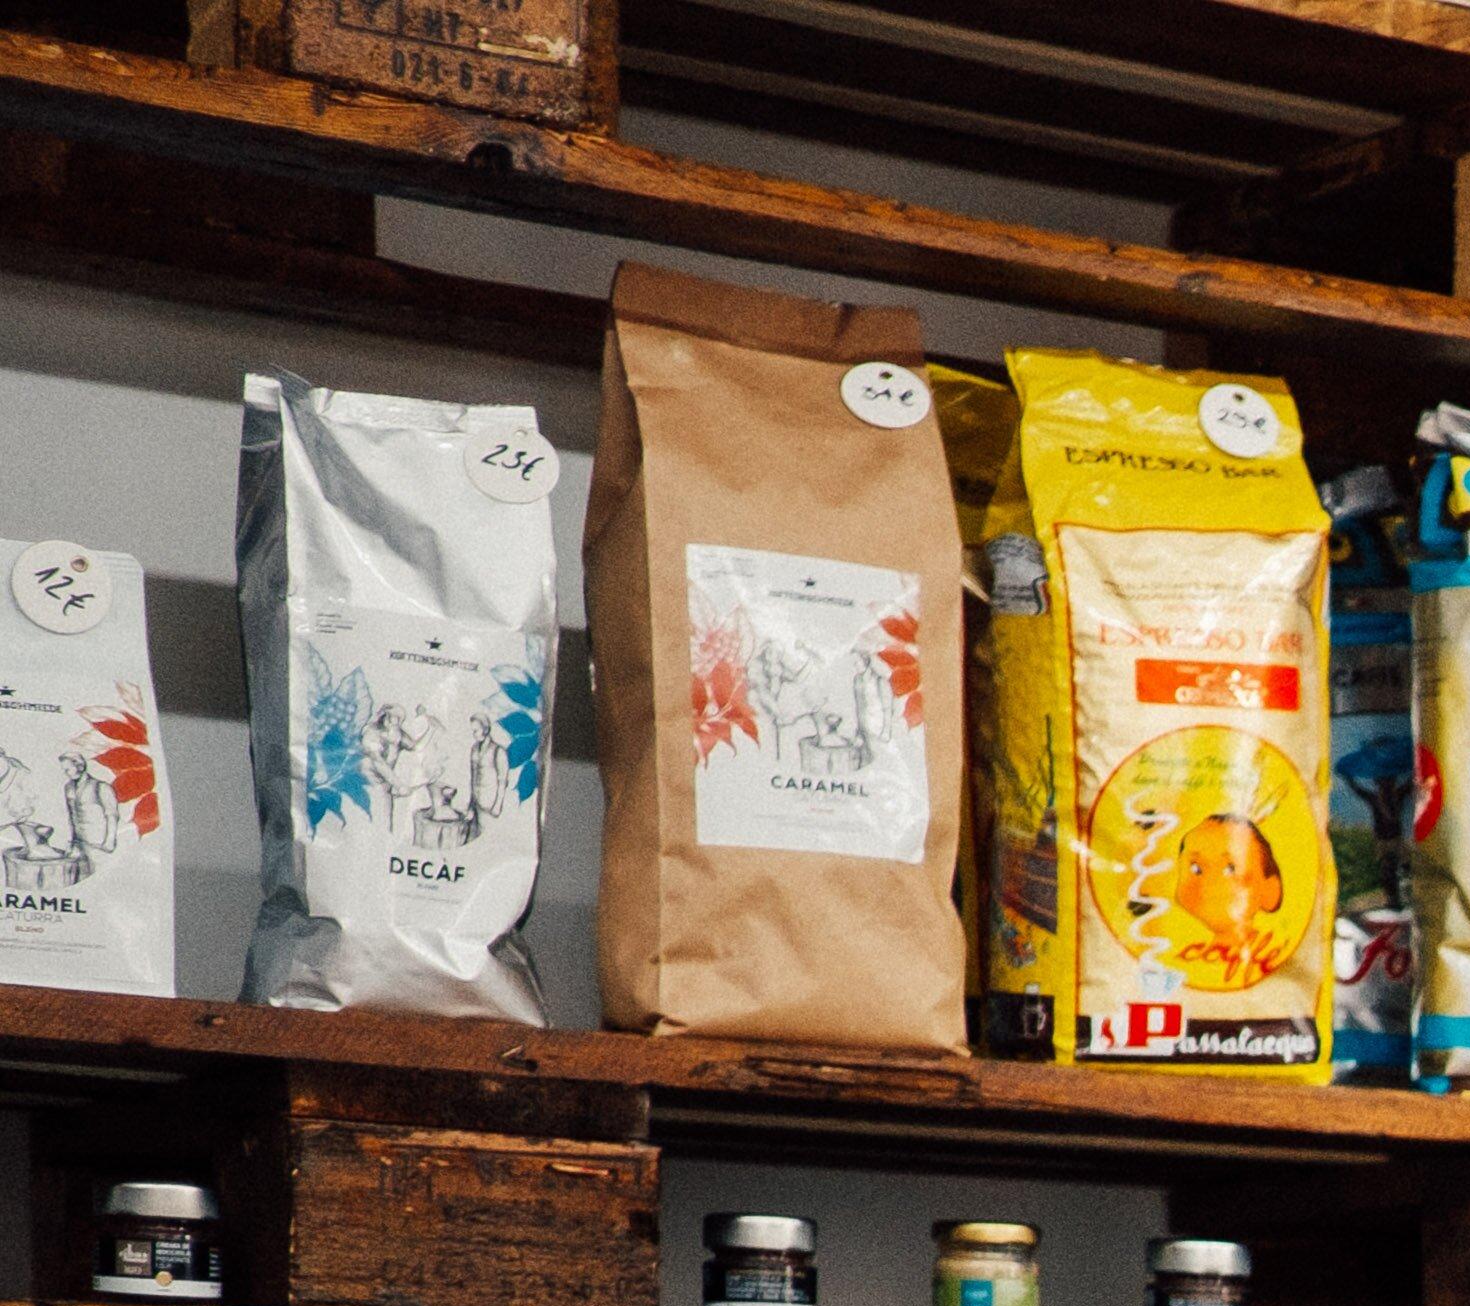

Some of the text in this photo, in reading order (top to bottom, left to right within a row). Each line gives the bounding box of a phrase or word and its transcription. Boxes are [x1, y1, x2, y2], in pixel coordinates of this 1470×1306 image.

[1064, 446, 1210, 475] ESPRESSO
[34, 566, 96, 617] 12€
[771, 775, 870, 798] CARAMEL
[389, 856, 466, 882] DECAF
